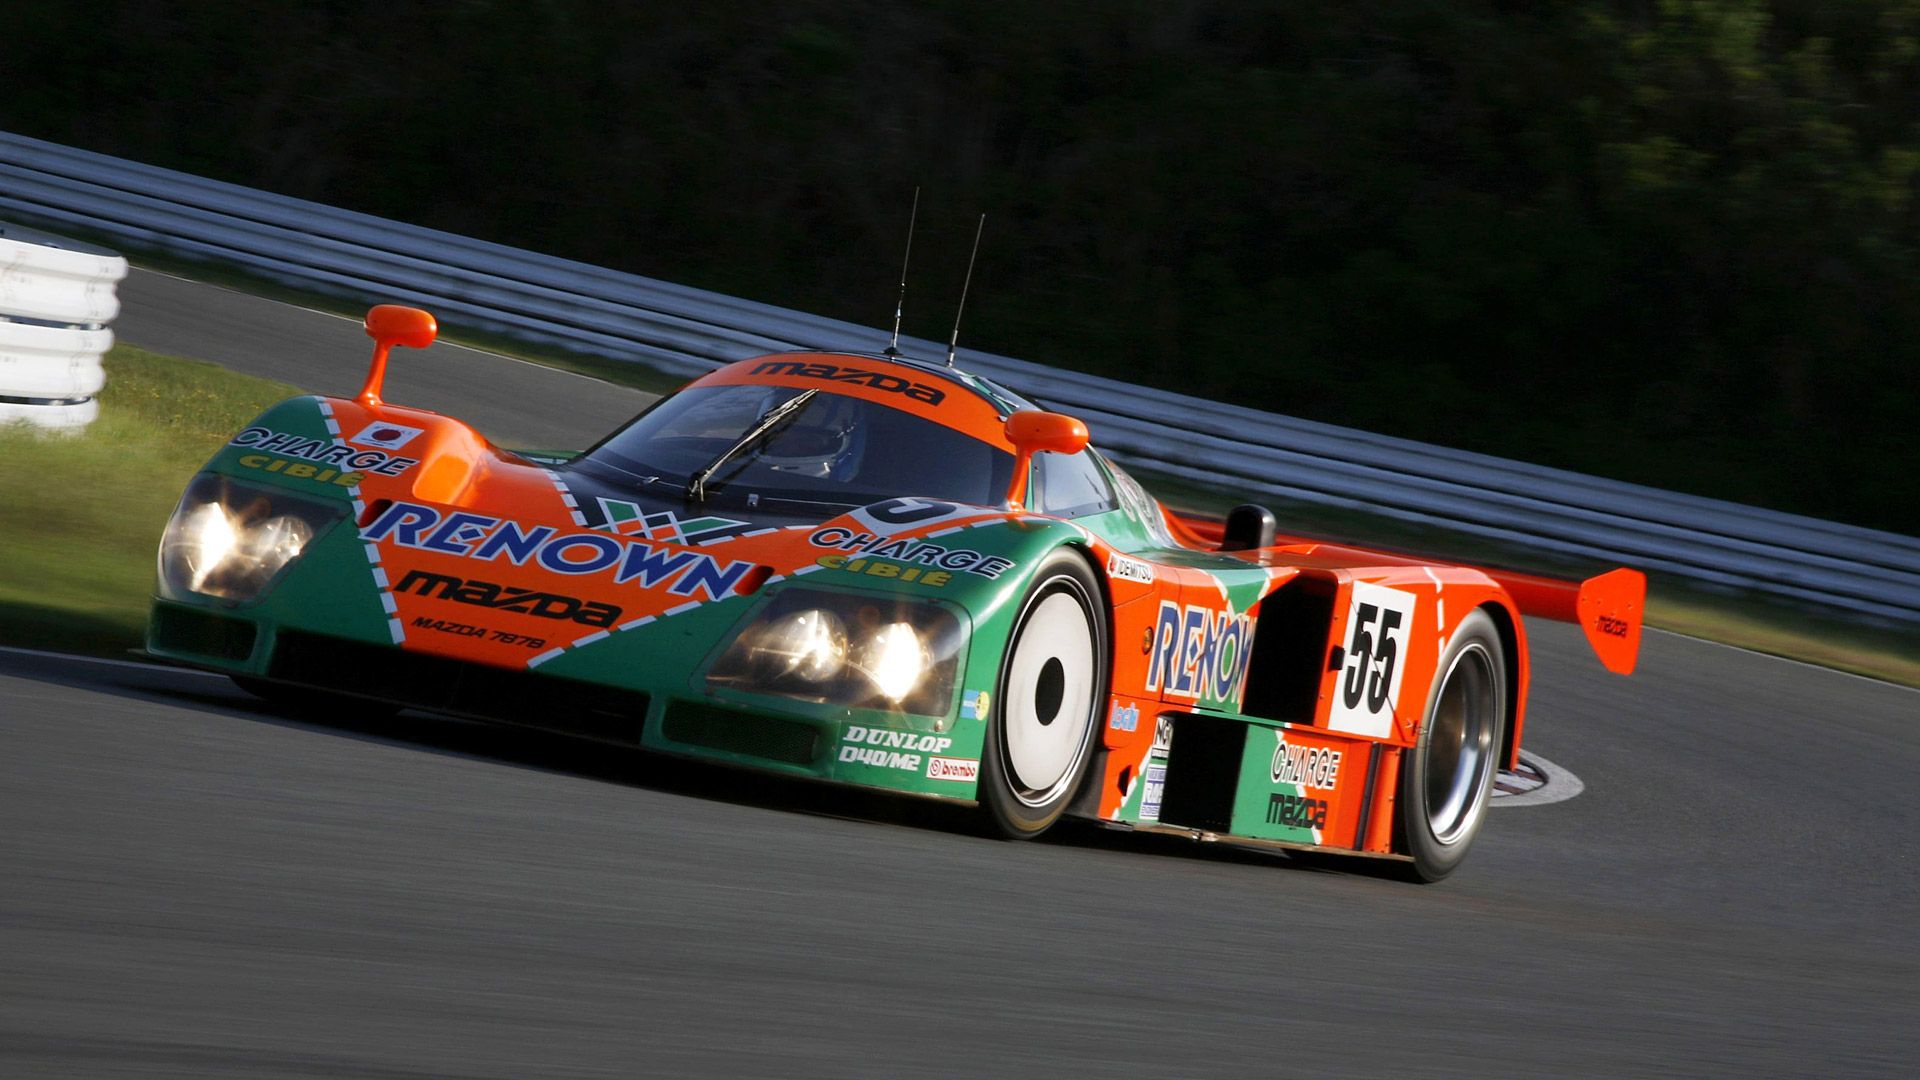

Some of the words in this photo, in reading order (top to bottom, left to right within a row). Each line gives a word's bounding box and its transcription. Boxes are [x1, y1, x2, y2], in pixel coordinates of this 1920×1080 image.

[750, 361, 947, 406] mazda
[228, 427, 421, 477] CHARGE
[358, 501, 756, 602] RENOWN
[808, 527, 1016, 580] CHARGE
[395, 570, 623, 628] mazda
[411, 617, 487, 638] MAZDA
[490, 630, 546, 649] 787B
[1596, 615, 1627, 638] mazda
[1344, 602, 1402, 714] 55
[838, 745, 921, 771] D40/M2
[843, 726, 952, 753] DUNLOP
[1271, 740, 1342, 789] CHARGE
[1266, 793, 1327, 829] mazda
